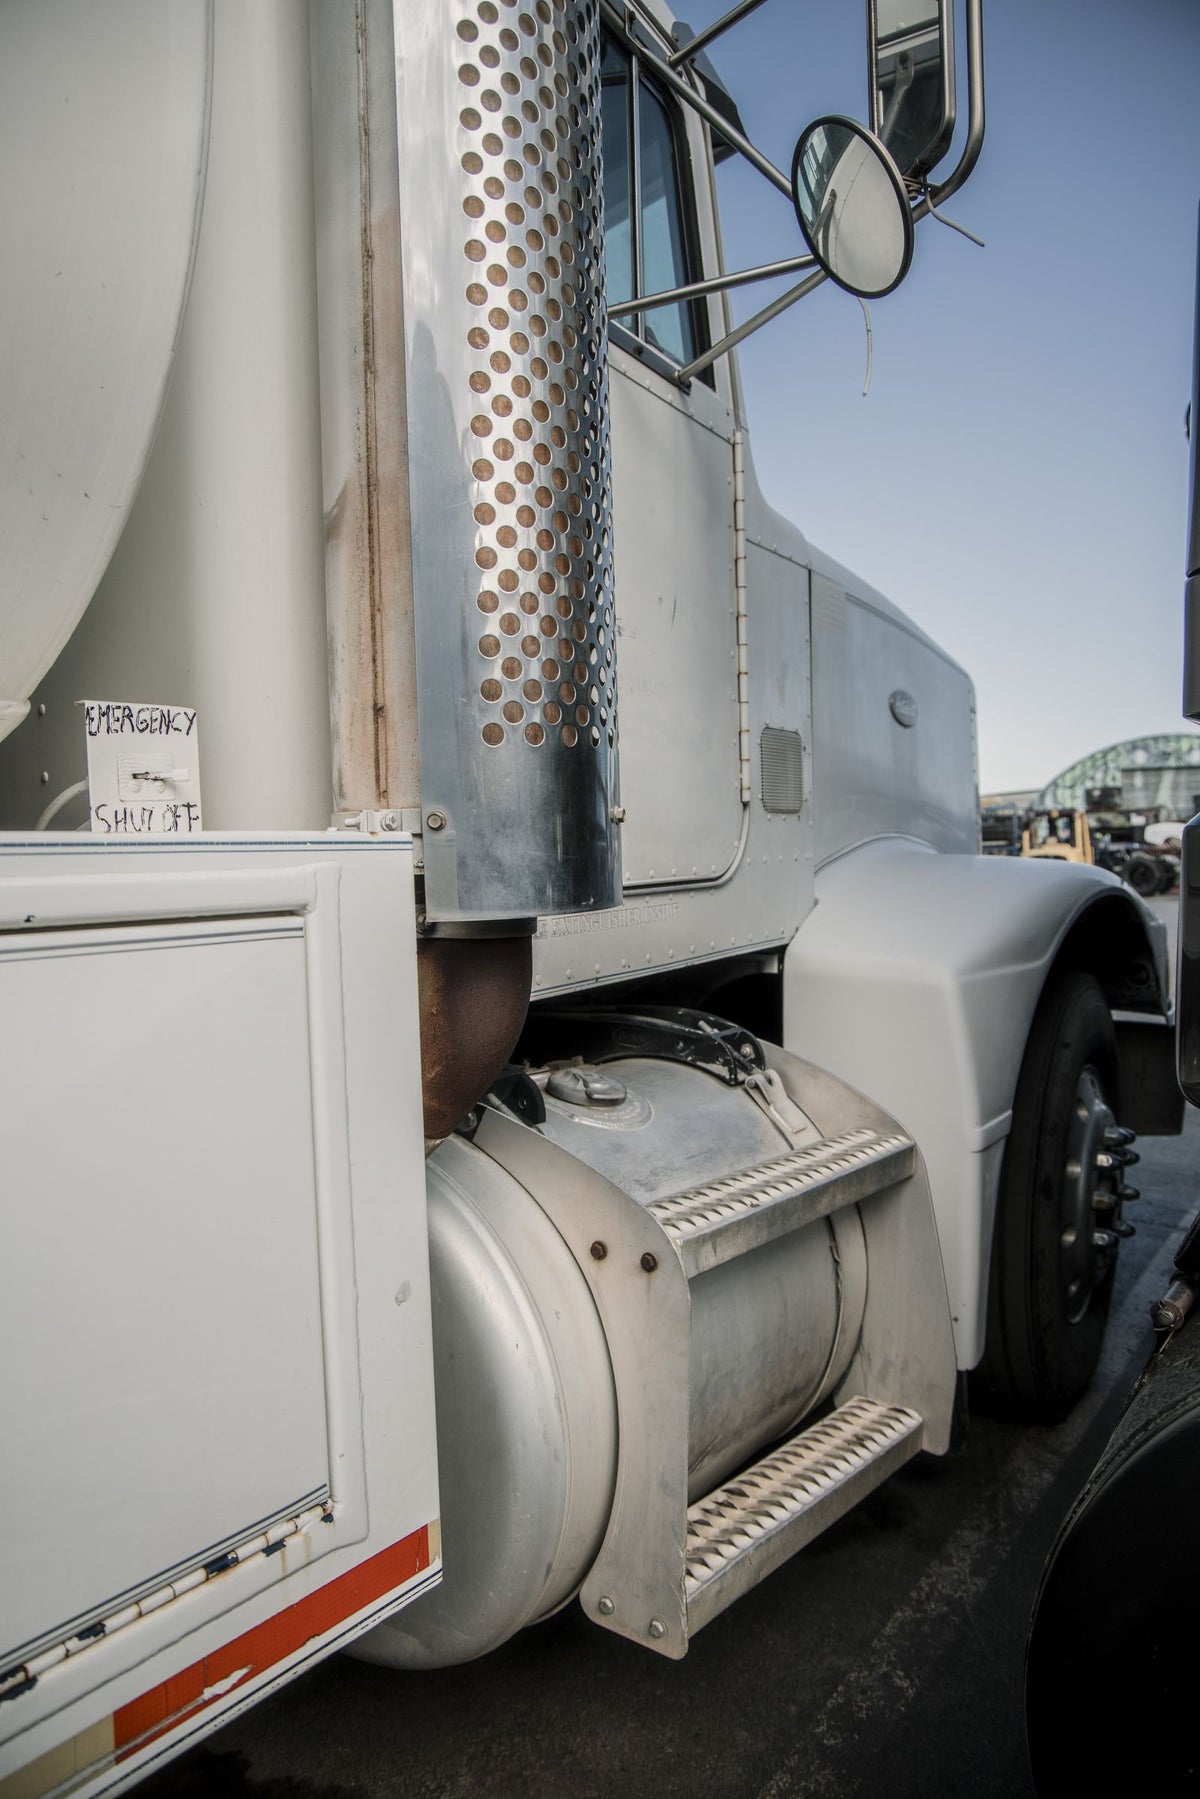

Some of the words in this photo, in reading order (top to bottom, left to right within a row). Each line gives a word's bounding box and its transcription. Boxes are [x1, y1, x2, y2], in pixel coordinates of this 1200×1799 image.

[86, 704, 197, 736] EMERGENCY
[95, 804, 155, 832] SHUT
[162, 802, 200, 832] OFF
[551, 908, 641, 937] EXTINGUISHER
[644, 903, 679, 923] INSIDE
